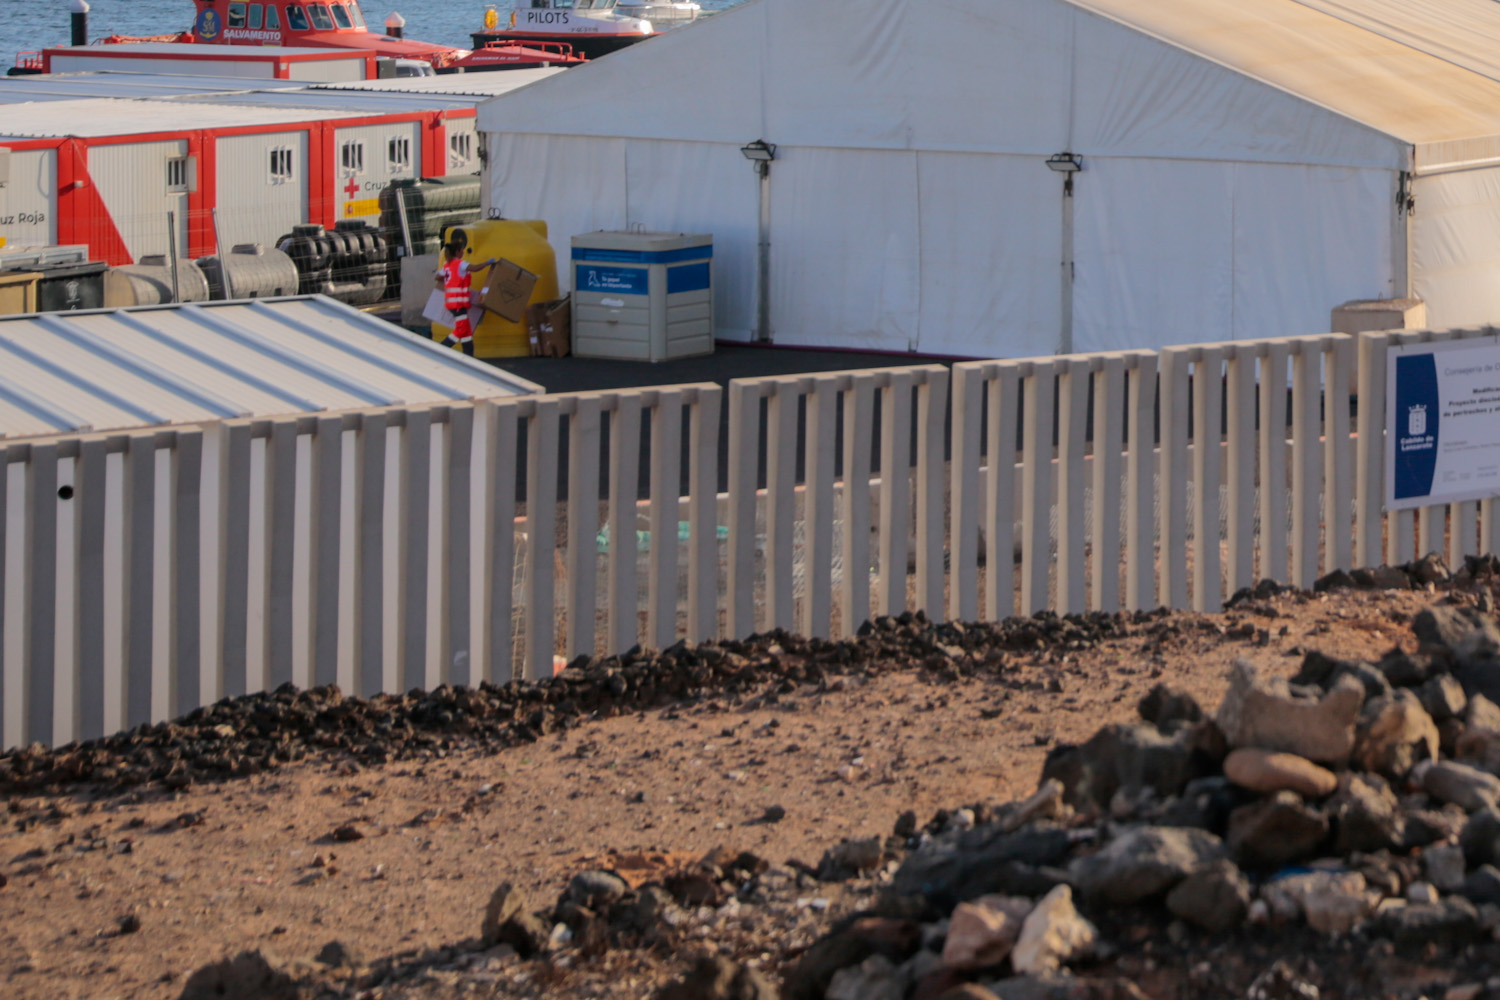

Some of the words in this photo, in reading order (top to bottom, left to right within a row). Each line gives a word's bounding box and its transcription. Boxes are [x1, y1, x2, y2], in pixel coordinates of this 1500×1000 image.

[528, 12, 569, 24] PILOTS
[223, 29, 281, 41] SALVAMENTO
[18, 211, 45, 225] Roja
